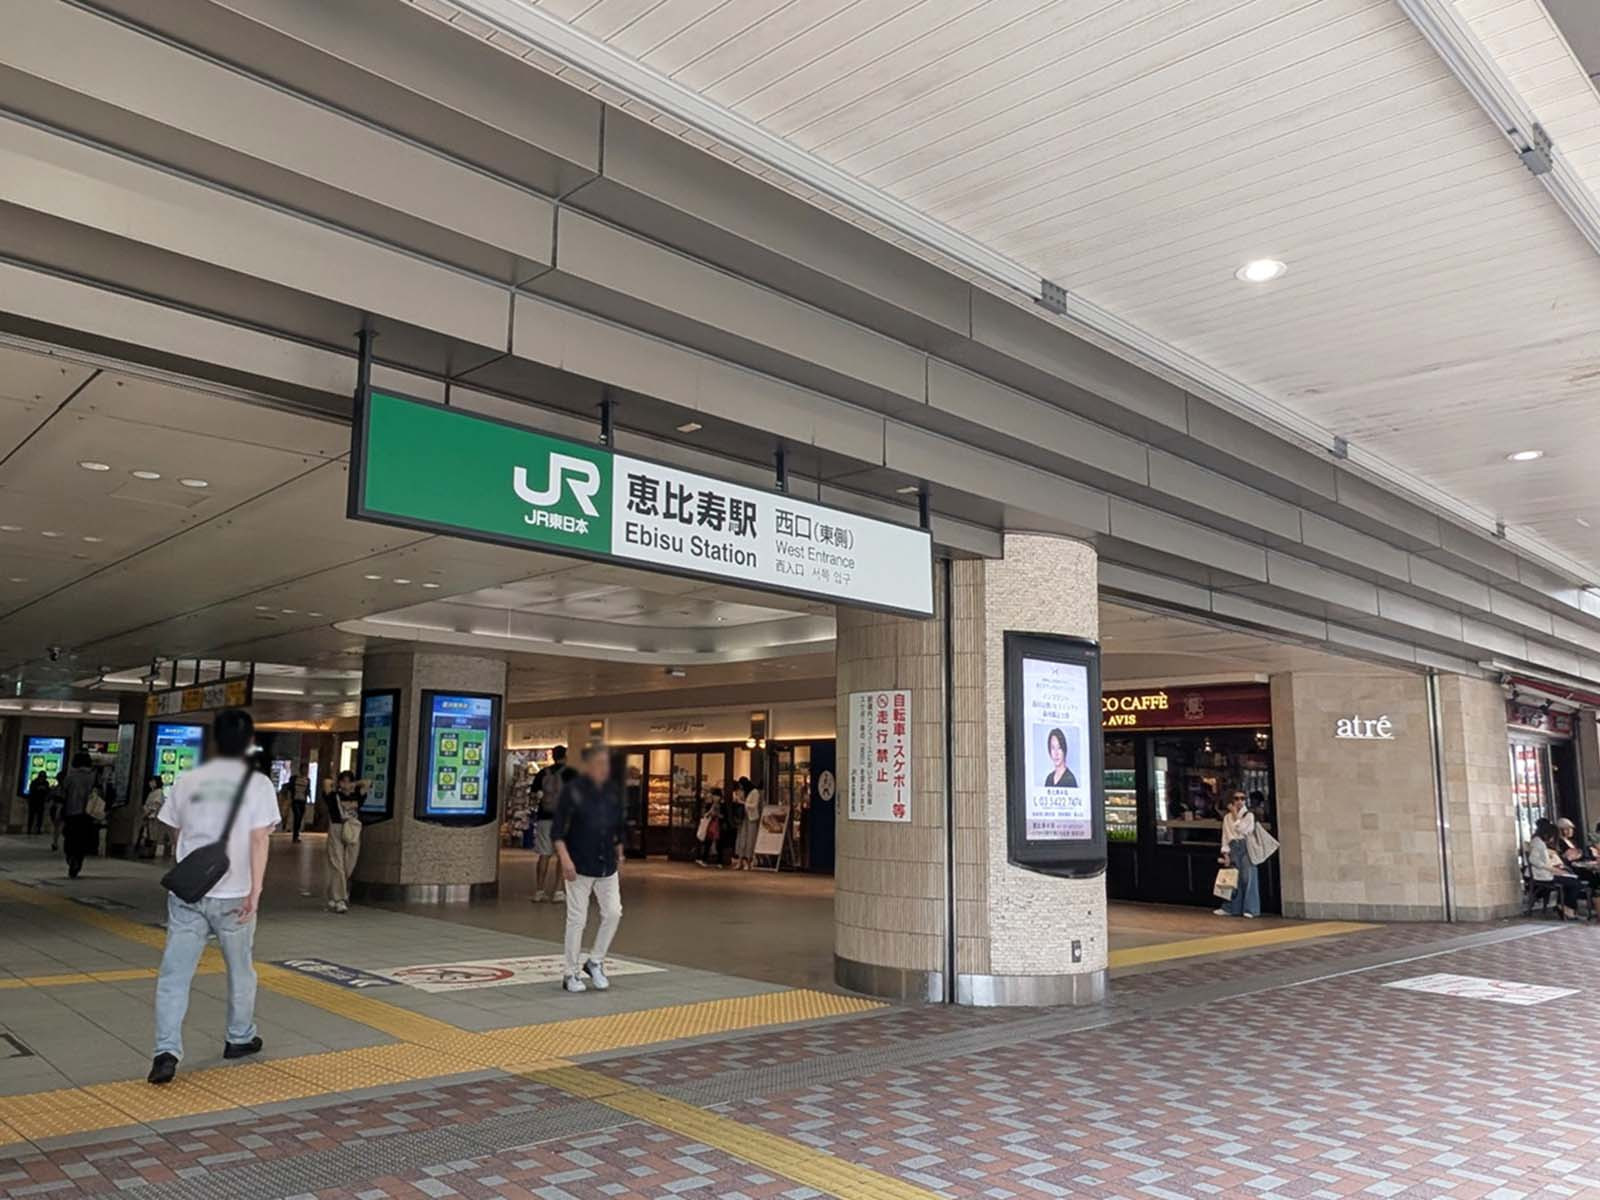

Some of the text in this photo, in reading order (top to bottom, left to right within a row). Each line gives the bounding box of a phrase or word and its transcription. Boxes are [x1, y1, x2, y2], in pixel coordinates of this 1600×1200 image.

[514, 452, 600, 517] JR
[524, 509, 589, 535] JR東日本
[626, 473, 757, 539] 恵比寿駅
[625, 521, 757, 568] Ebisu Station
[775, 539, 855, 569] West Entrance
[1108, 714, 1136, 726] AVIS
[1120, 691, 1168, 711] CAFFÈ
[1335, 714, 1393, 738] atré
[876, 710, 889, 783] 走行禁止
[892, 694, 906, 819] 自転車・スケボー等
